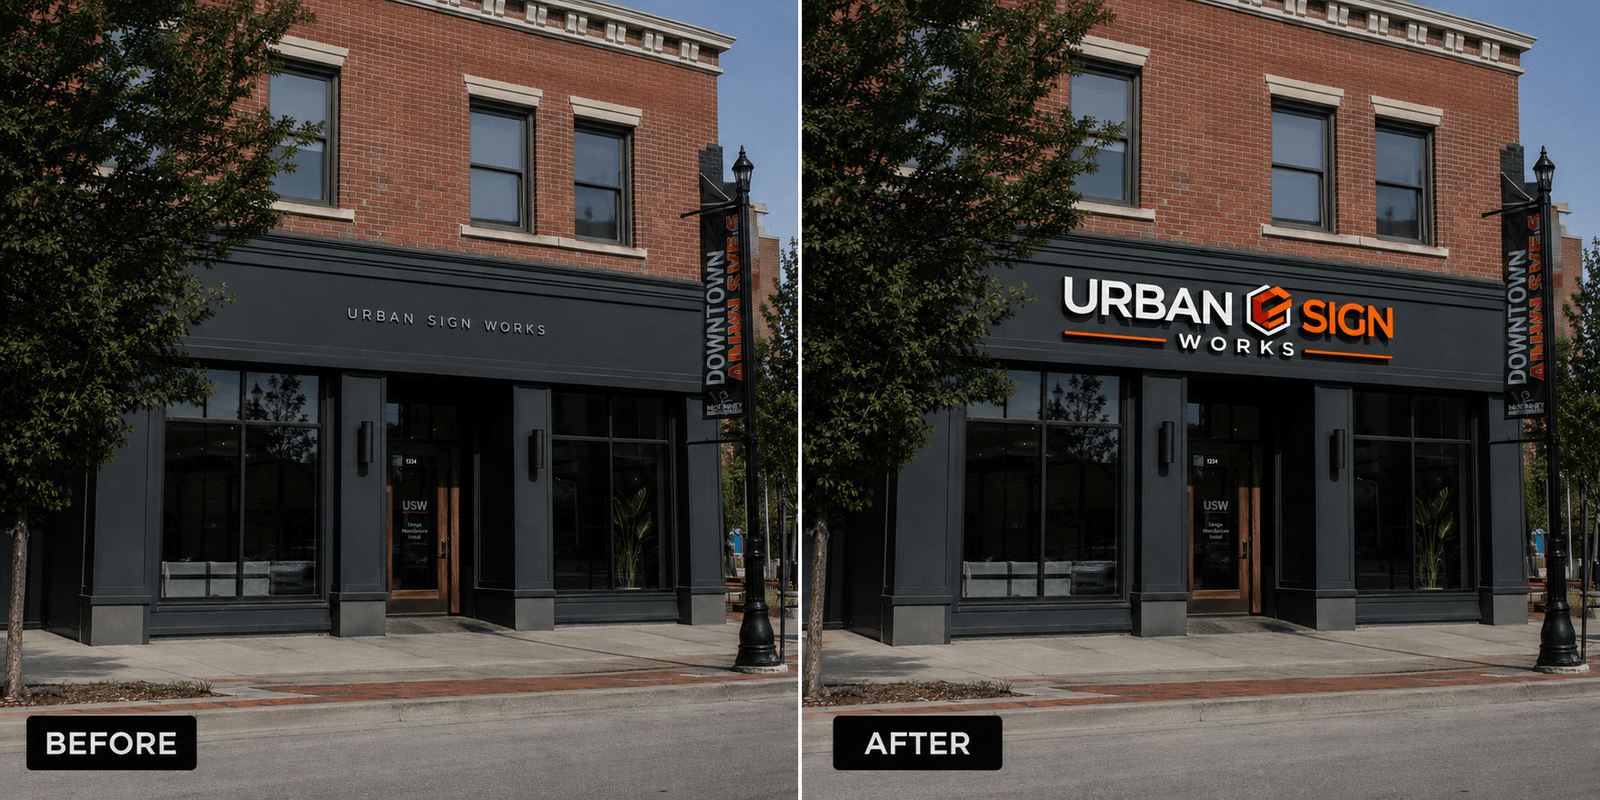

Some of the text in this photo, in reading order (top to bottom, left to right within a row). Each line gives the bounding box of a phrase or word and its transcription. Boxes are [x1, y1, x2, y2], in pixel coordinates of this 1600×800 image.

[347, 307, 546, 335] URBAN SIGN WORKS
[706, 250, 726, 385] DOWNTOWN
[1063, 275, 1394, 339] URBAN SIGN
[1507, 250, 1527, 385] DOWNTOWN
[1178, 333, 1295, 357] WORKS
[402, 500, 428, 511] USW
[1203, 500, 1229, 511] USW
